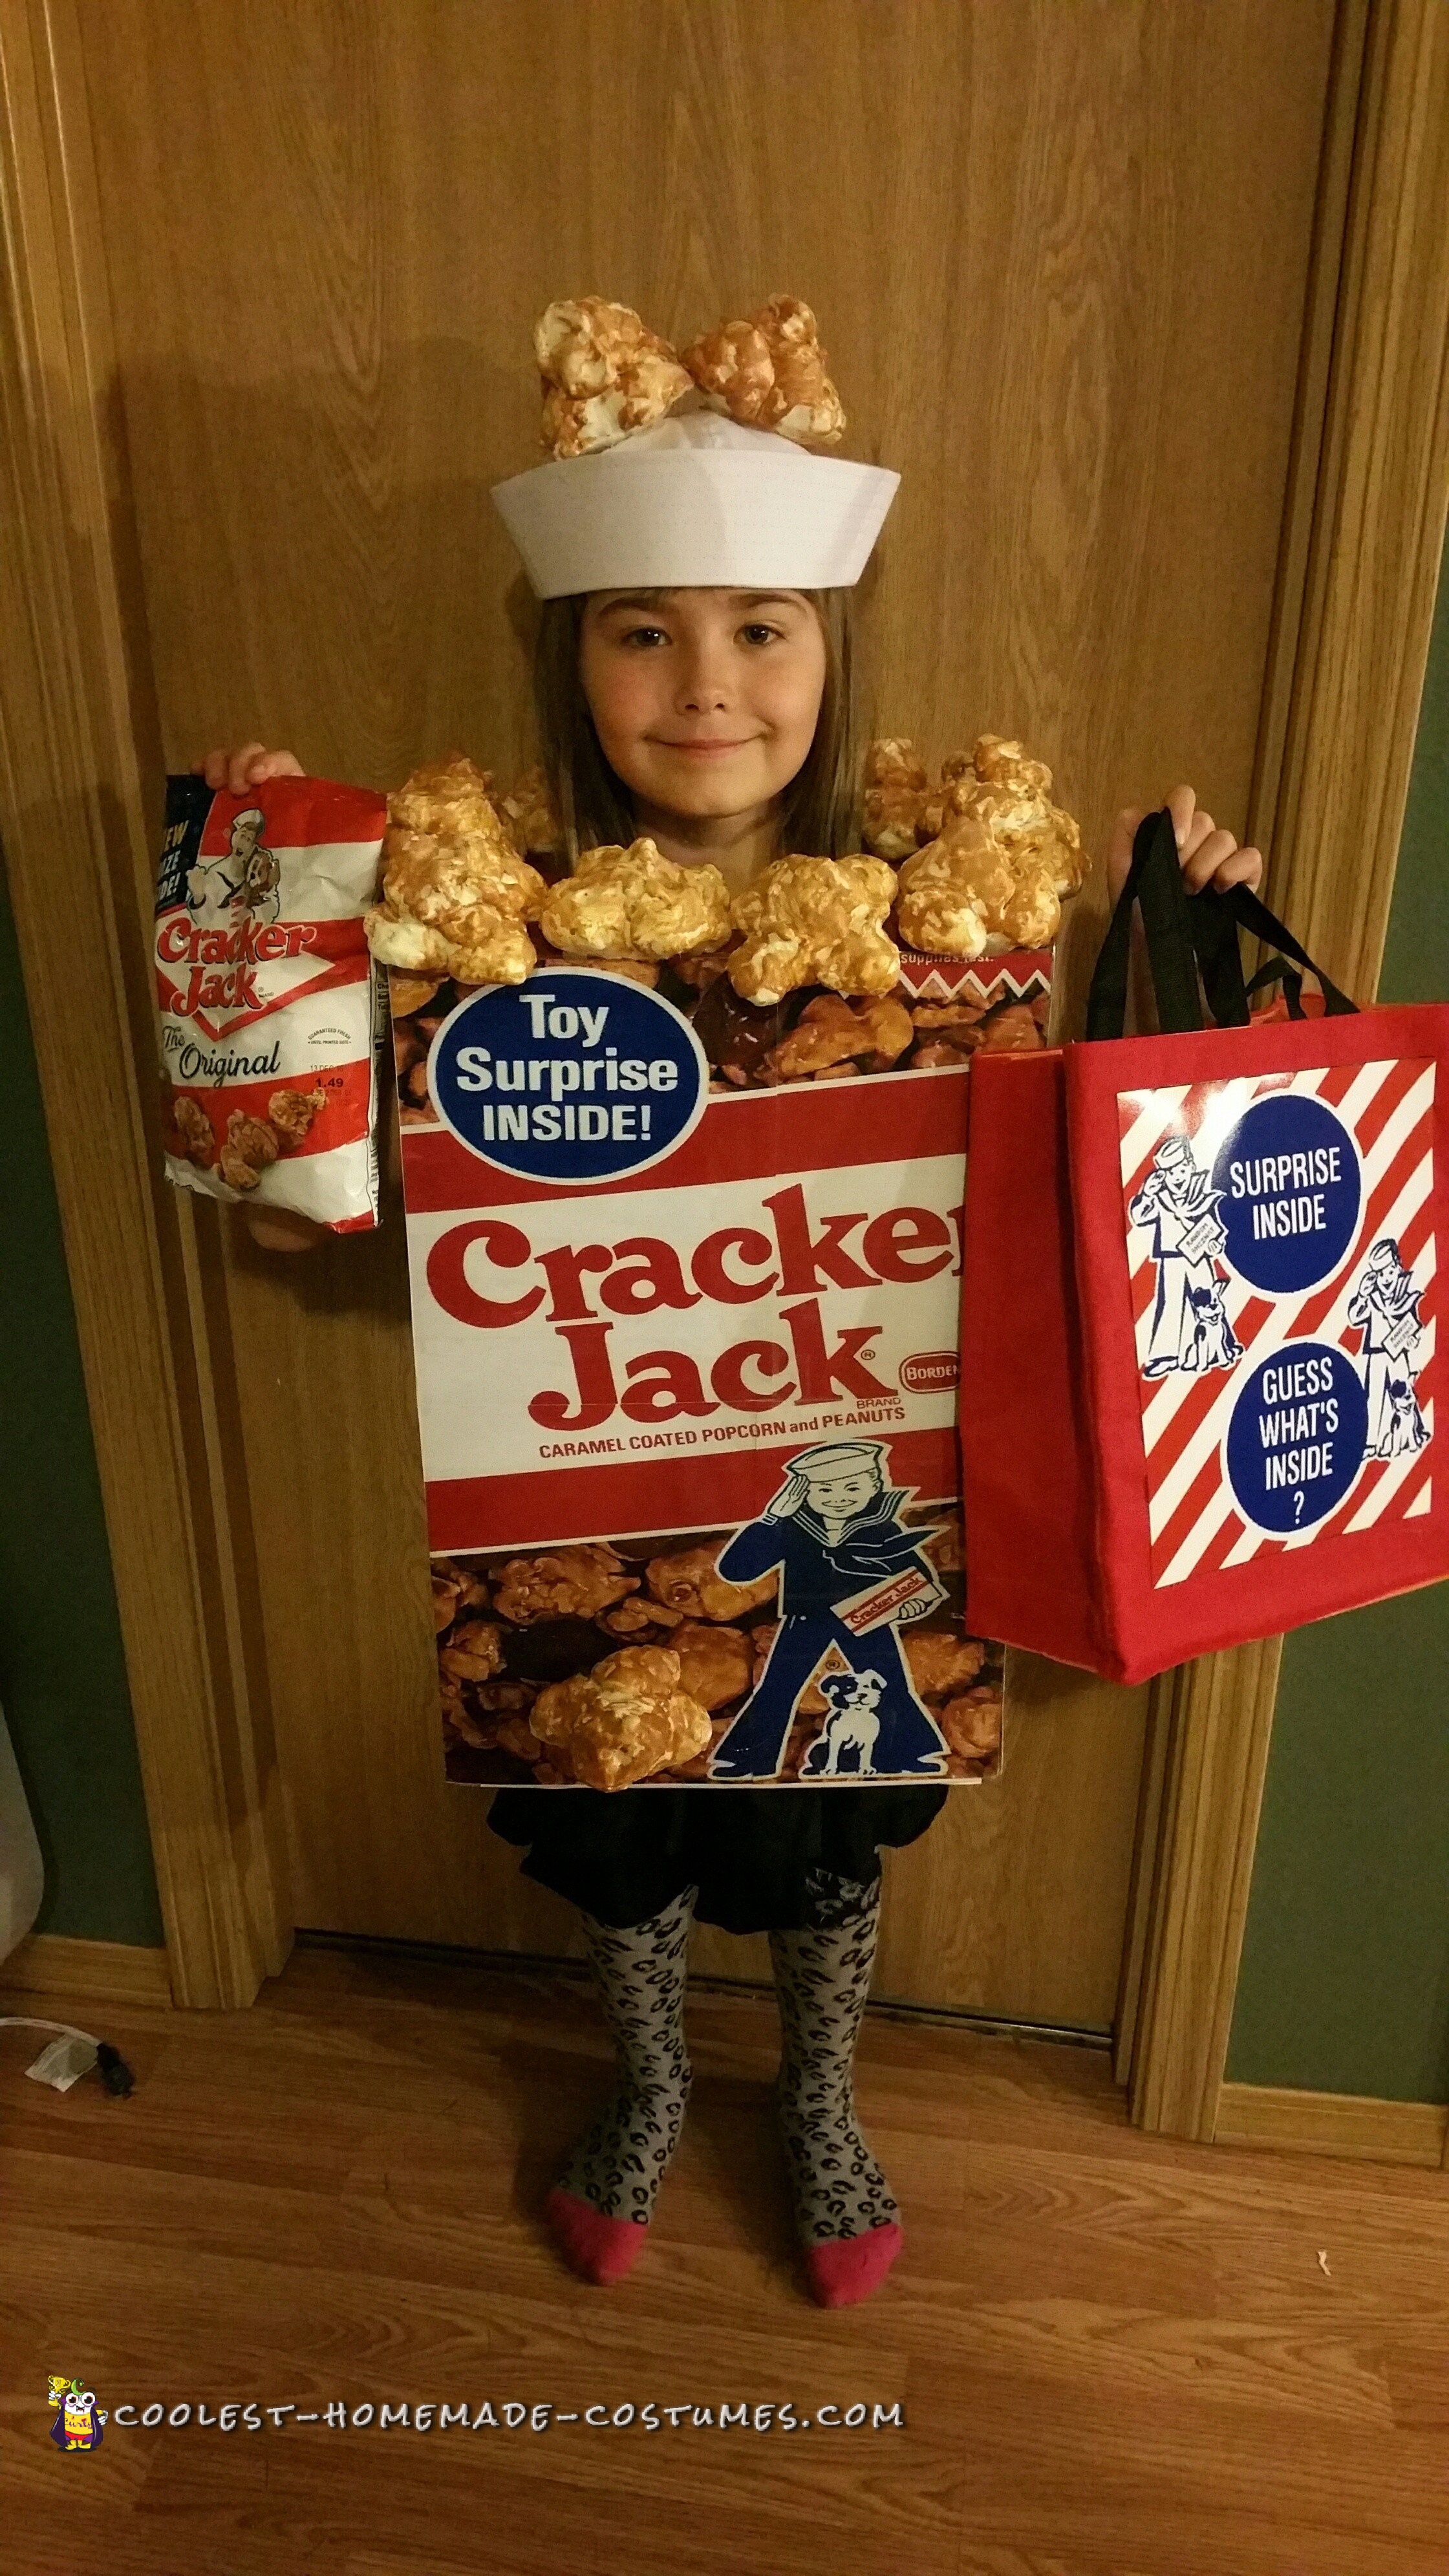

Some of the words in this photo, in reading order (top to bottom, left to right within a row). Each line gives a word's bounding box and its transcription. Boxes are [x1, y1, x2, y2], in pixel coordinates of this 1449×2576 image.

[157, 916, 317, 965] Cracker
[171, 962, 265, 1017] Jack
[163, 1025, 185, 1052] The
[519, 994, 609, 1047] Toy
[179, 1040, 281, 1088] Original
[316, 1077, 343, 1088] 1.49
[456, 1047, 678, 1101] Surprise
[483, 1105, 651, 1141] INSIDE!
[1230, 1147, 1342, 1198] SURPRISE
[1253, 1194, 1326, 1240] INSIDE
[527, 1298, 899, 1431] Jack
[1263, 1357, 1333, 1405] GUESS
[857, 1397, 901, 1409] BRAND
[1259, 1398, 1339, 1448] WHAT'S
[539, 1438, 626, 1458] CARAMEL
[629, 1430, 697, 1450] COATED
[702, 1421, 786, 1442] POPCORN
[789, 1417, 819, 1433] and
[822, 1406, 905, 1428] PEANUTS
[1265, 1441, 1333, 1491] INSIDE
[1294, 1490, 1305, 1525] ?
[850, 1594, 894, 1624] Cracker
[894, 1578, 923, 1596] Jack
